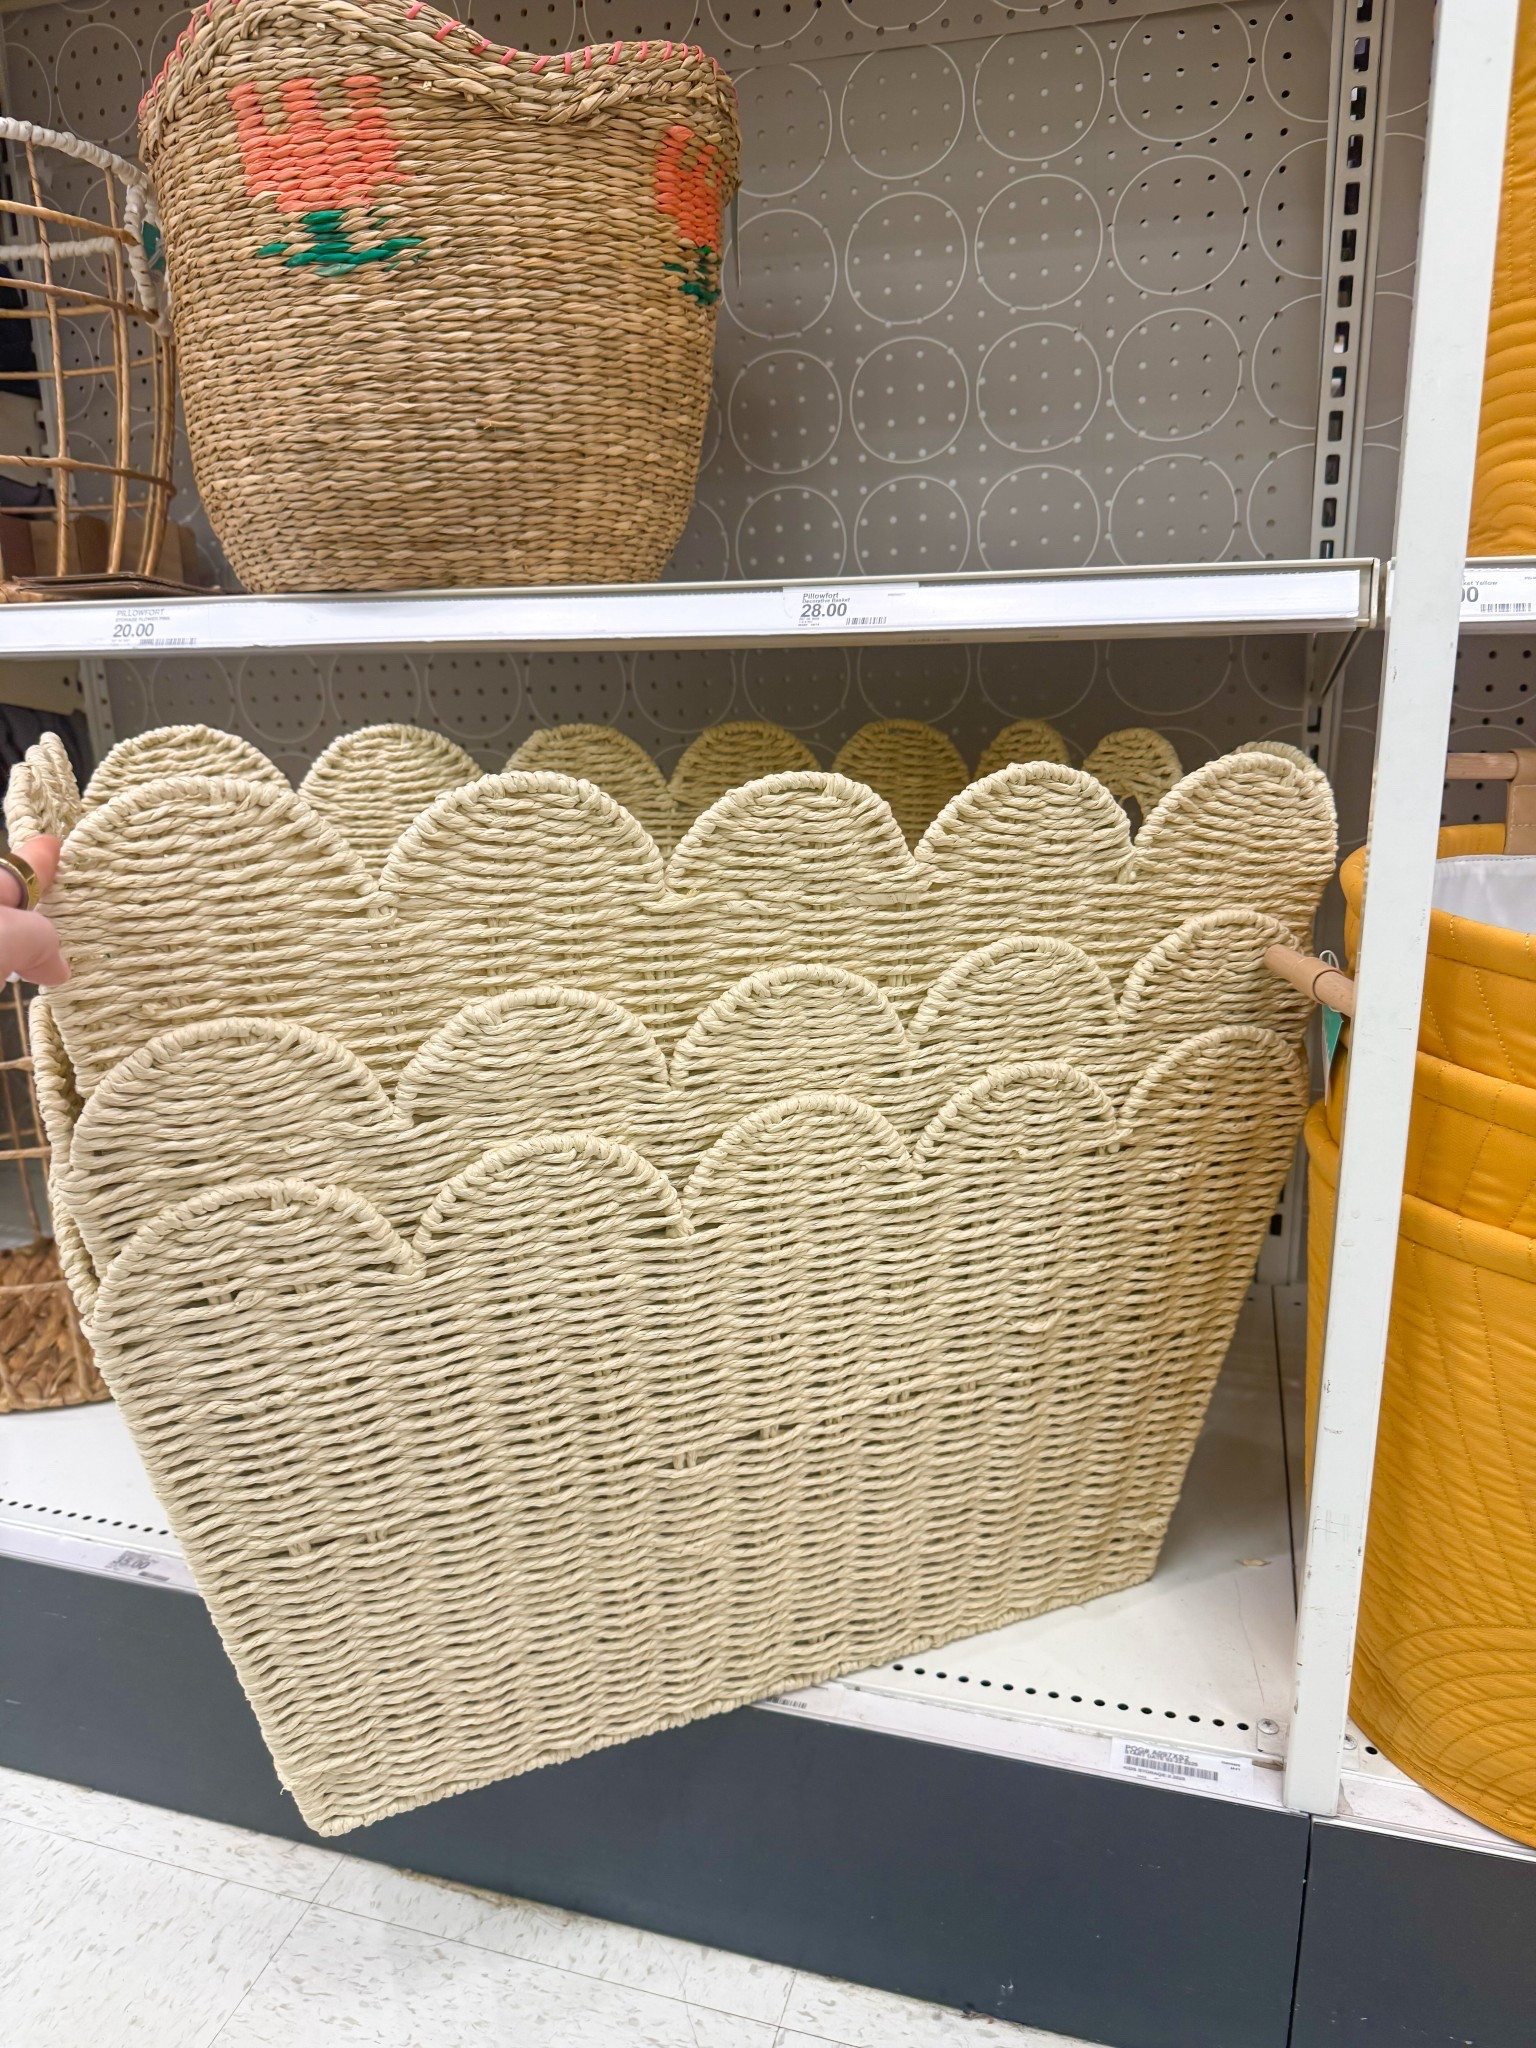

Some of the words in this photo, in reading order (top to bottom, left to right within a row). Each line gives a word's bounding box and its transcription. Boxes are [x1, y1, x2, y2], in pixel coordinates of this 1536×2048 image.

[803, 592, 839, 600] Pillowfort
[116, 608, 165, 617] PILLOWFORT
[800, 602, 848, 618] 28.00
[112, 623, 155, 638] 20.00
